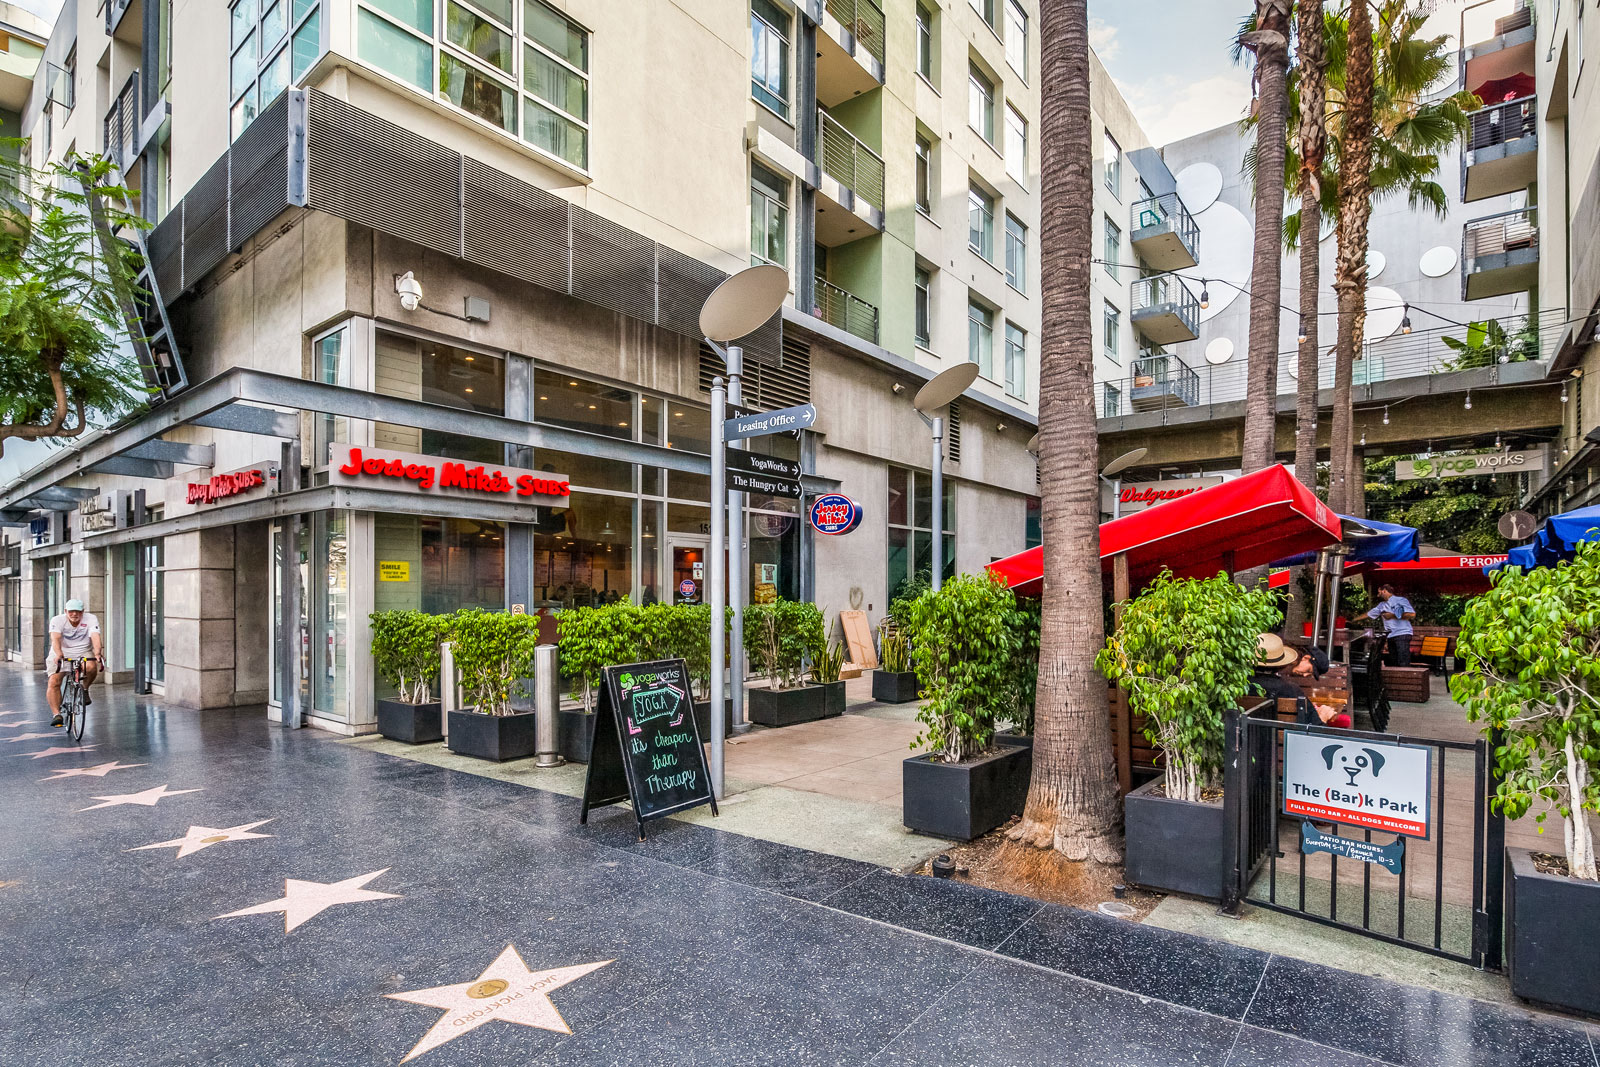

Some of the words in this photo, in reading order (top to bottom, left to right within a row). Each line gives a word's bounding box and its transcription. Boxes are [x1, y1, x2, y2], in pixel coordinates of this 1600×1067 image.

[738, 420, 768, 433] Leasing
[769, 415, 796, 427] Office
[339, 448, 436, 488] Jersey
[439, 462, 514, 492] Mike's
[516, 475, 571, 496] SUBS
[750, 457, 788, 472] YogaWorks
[1436, 453, 1524, 473] yogaworks
[186, 483, 211, 504] Jersey
[209, 475, 233, 499] Mike's
[233, 469, 261, 493] SUBS
[733, 475, 748, 486] The
[749, 478, 776, 493] Hungry
[777, 482, 789, 493] Cat
[1120, 486, 1202, 506] Walgreen
[816, 502, 849, 516] Jersey
[700, 523, 711, 535] 15
[817, 513, 849, 526] Mike's
[634, 669, 680, 685] yogaworks
[636, 695, 669, 718] YOGA
[631, 738, 648, 754] it's
[655, 730, 692, 748] cheaper
[652, 754, 678, 770] than
[645, 769, 696, 794] Therapy
[1292, 783, 1320, 798] The
[1325, 787, 1374, 808] (Bar)k
[1379, 797, 1418, 815] Park
[1290, 803, 1306, 811] FULL
[1306, 806, 1326, 815] PATIO
[1327, 810, 1341, 818] BAR
[1362, 816, 1382, 825] DOGS
[1383, 819, 1421, 832] WELCOME
[1319, 835, 1340, 843] PATIO
[1356, 843, 1384, 853] HOURS:
[526, 974, 557, 993] JACK
[453, 992, 524, 1027] PICKFORD
